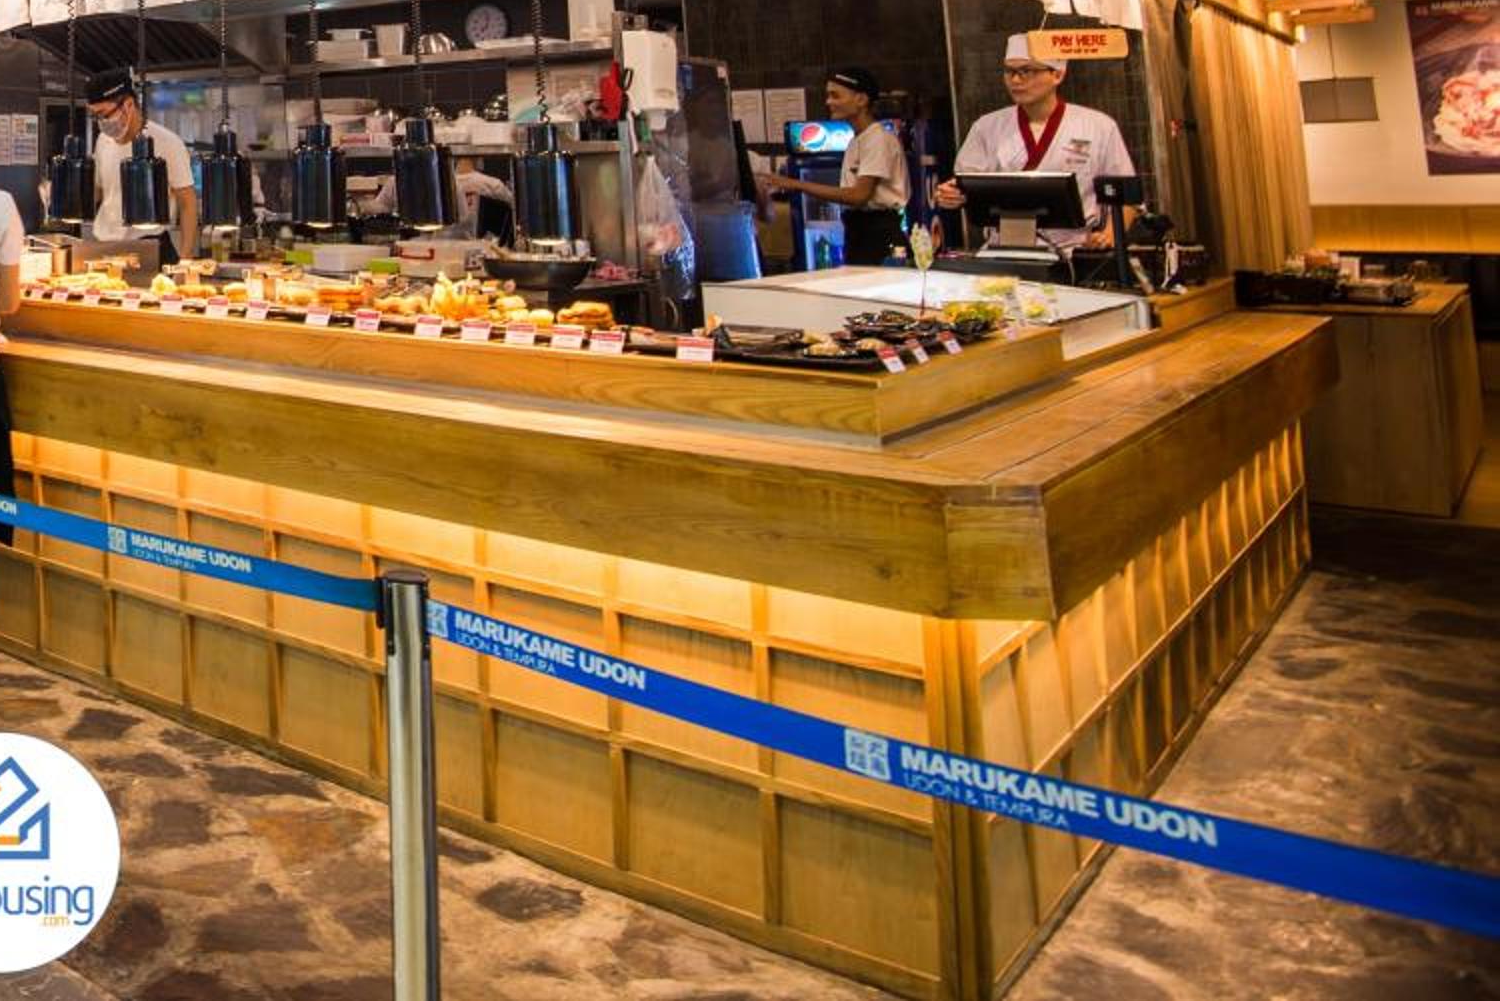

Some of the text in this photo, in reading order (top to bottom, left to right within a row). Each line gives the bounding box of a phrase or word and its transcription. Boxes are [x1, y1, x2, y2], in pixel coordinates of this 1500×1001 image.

[1052, 34, 1108, 46] PAY HERE
[130, 533, 207, 564] MARUKAME
[208, 550, 252, 573] UDON
[454, 610, 576, 668] MARUKAME
[579, 652, 646, 691] UDON
[456, 631, 490, 653] UDON
[504, 647, 556, 675] TEMPURA
[900, 745, 1218, 847] MARUKAME UDON
[903, 772, 1071, 829] UDON & TEMPURA
